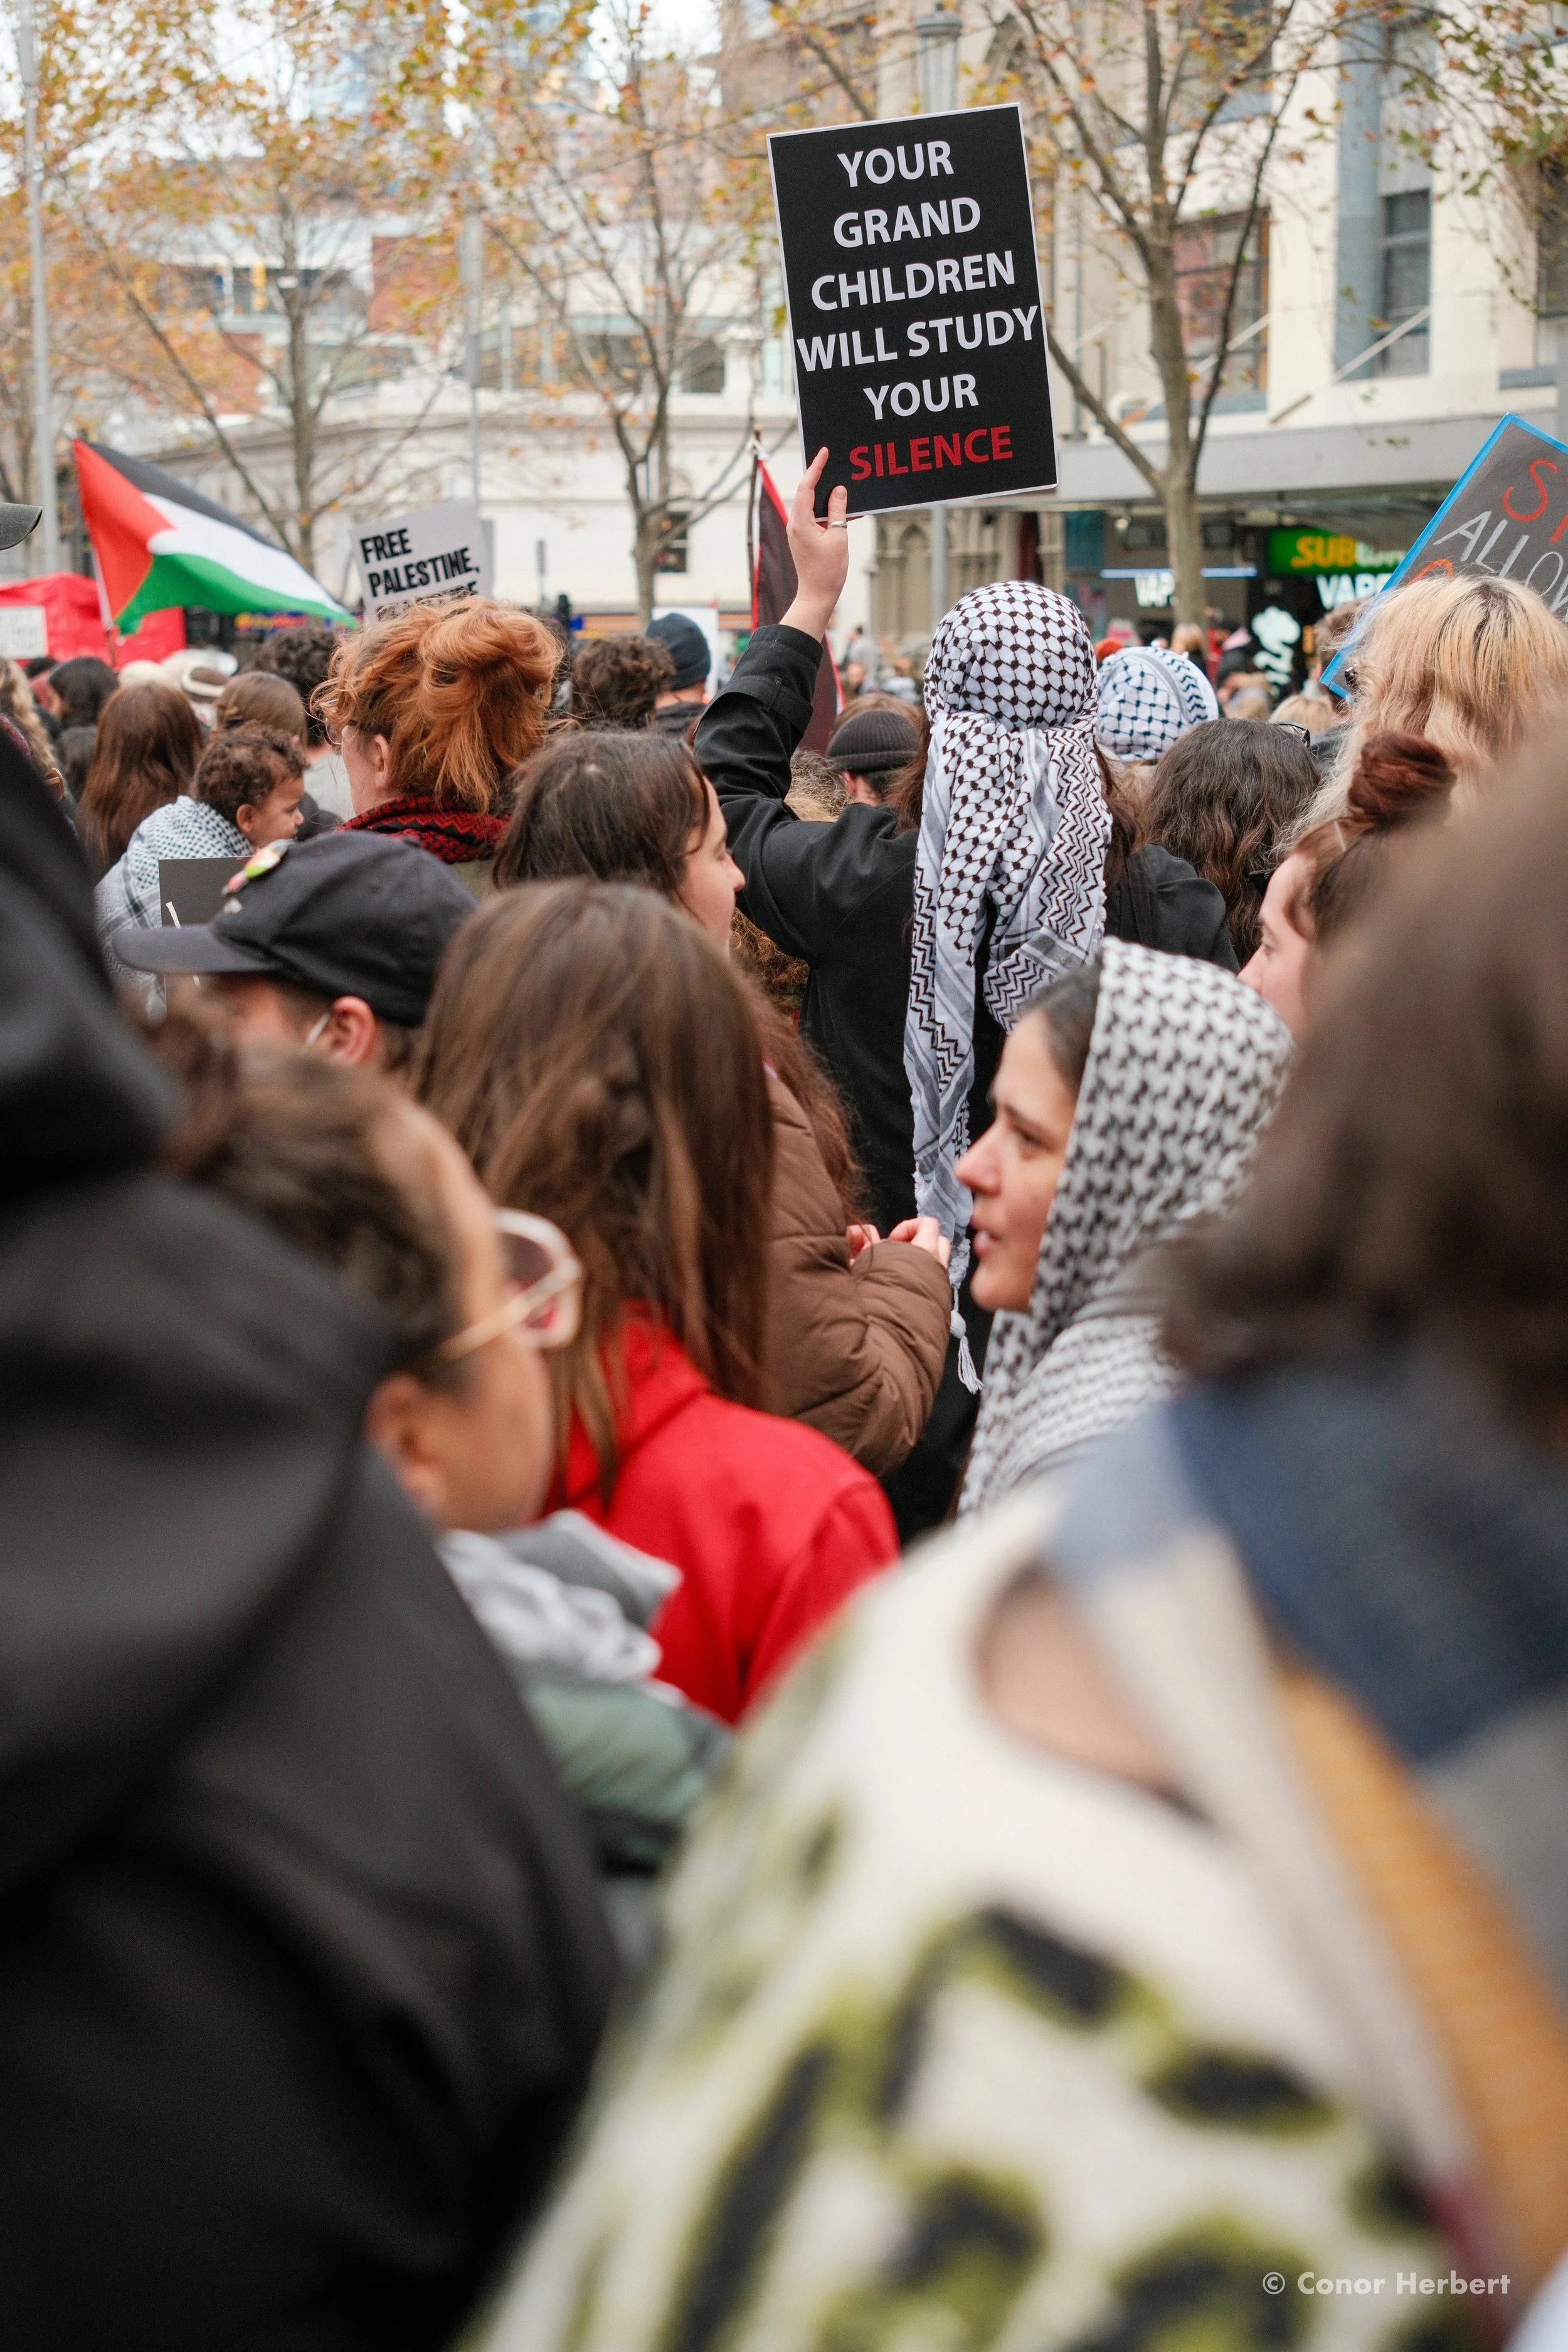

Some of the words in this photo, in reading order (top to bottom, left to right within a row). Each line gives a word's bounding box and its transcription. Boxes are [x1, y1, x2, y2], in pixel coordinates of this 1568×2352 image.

[836, 140, 955, 188] YOUR
[834, 197, 981, 248] GRAND
[811, 250, 1015, 310] CHILDREN
[796, 327, 898, 372] WILL
[906, 305, 1039, 358] STUDY
[862, 374, 979, 420] YOUR
[849, 425, 1013, 480] SILENCE
[359, 528, 412, 564] FREE
[368, 547, 480, 598] PALESTINE,
